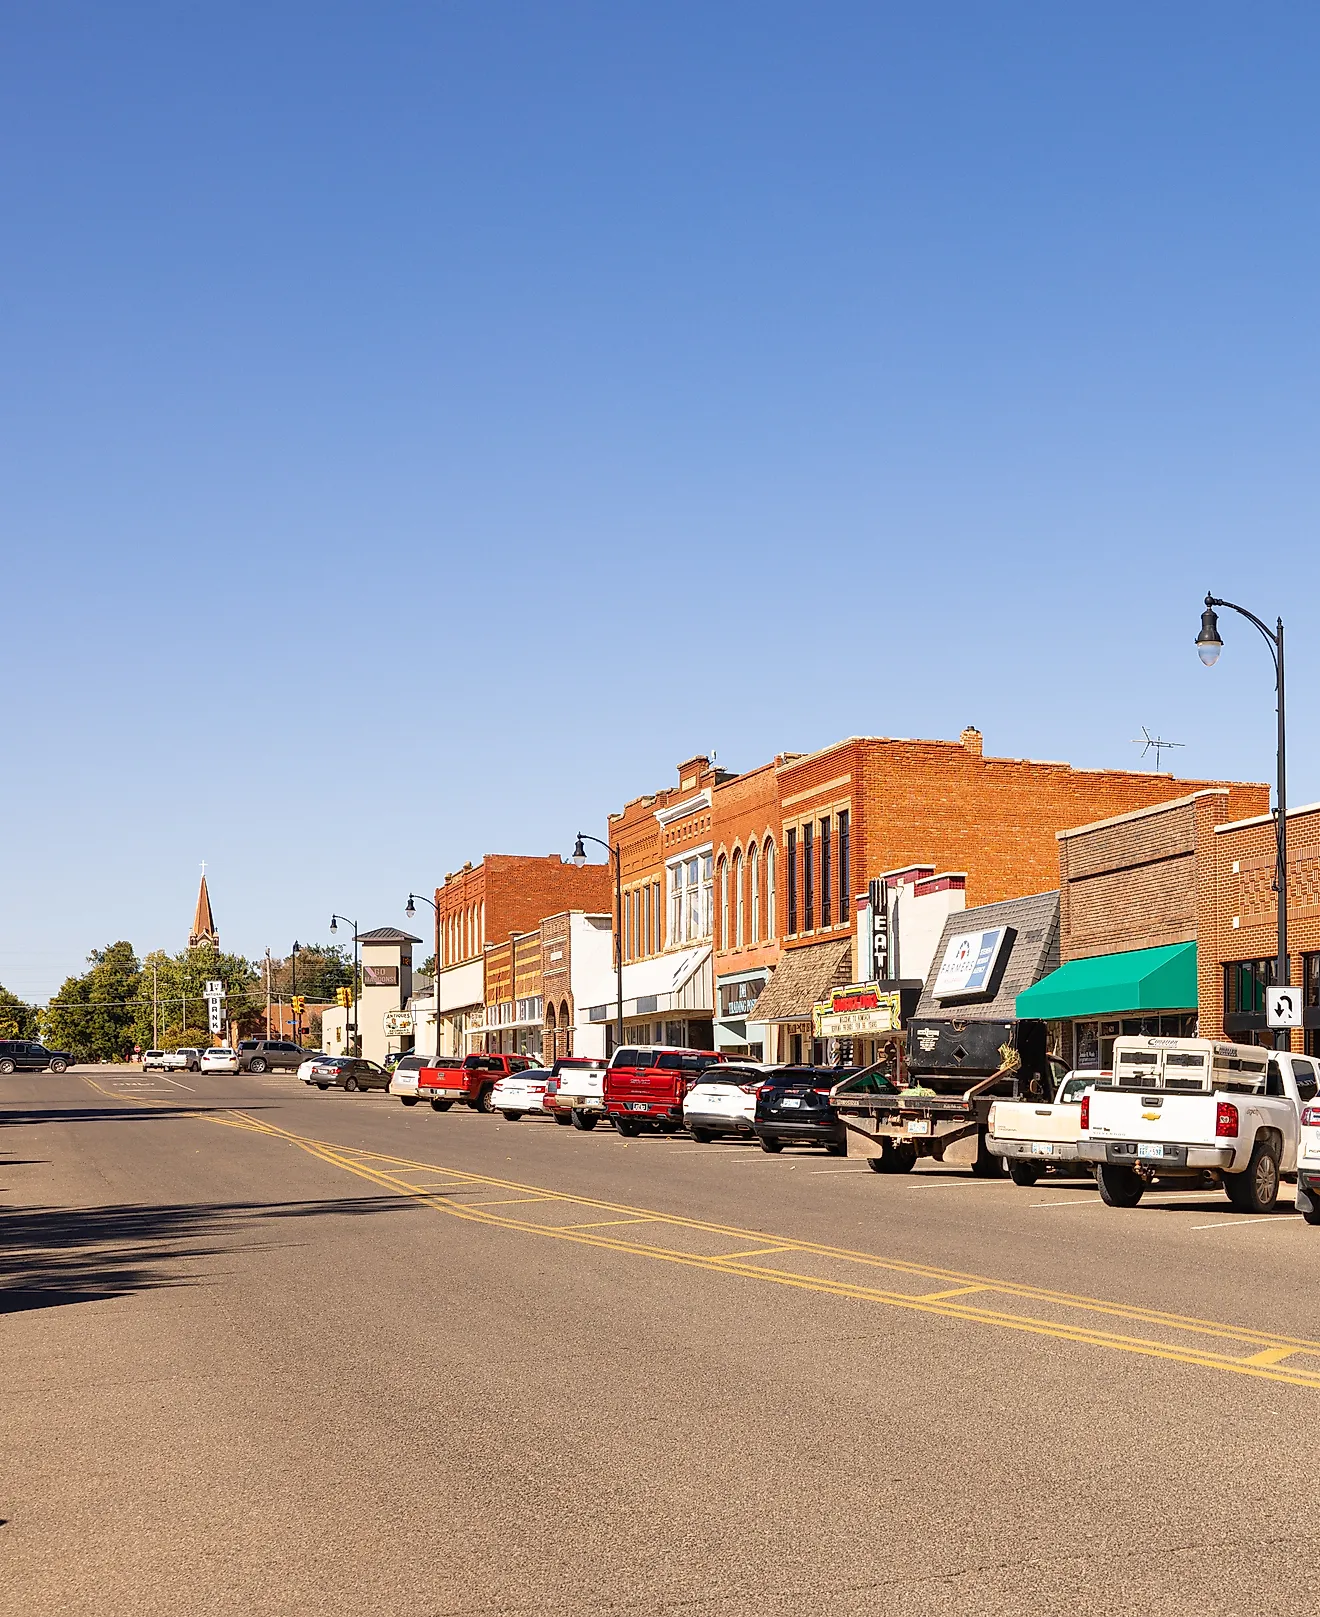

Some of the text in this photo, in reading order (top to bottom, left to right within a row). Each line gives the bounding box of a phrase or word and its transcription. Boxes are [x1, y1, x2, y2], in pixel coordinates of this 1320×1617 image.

[873, 915, 888, 968] EAT
[375, 968, 385, 976] GO
[211, 998, 219, 1029] BANK
